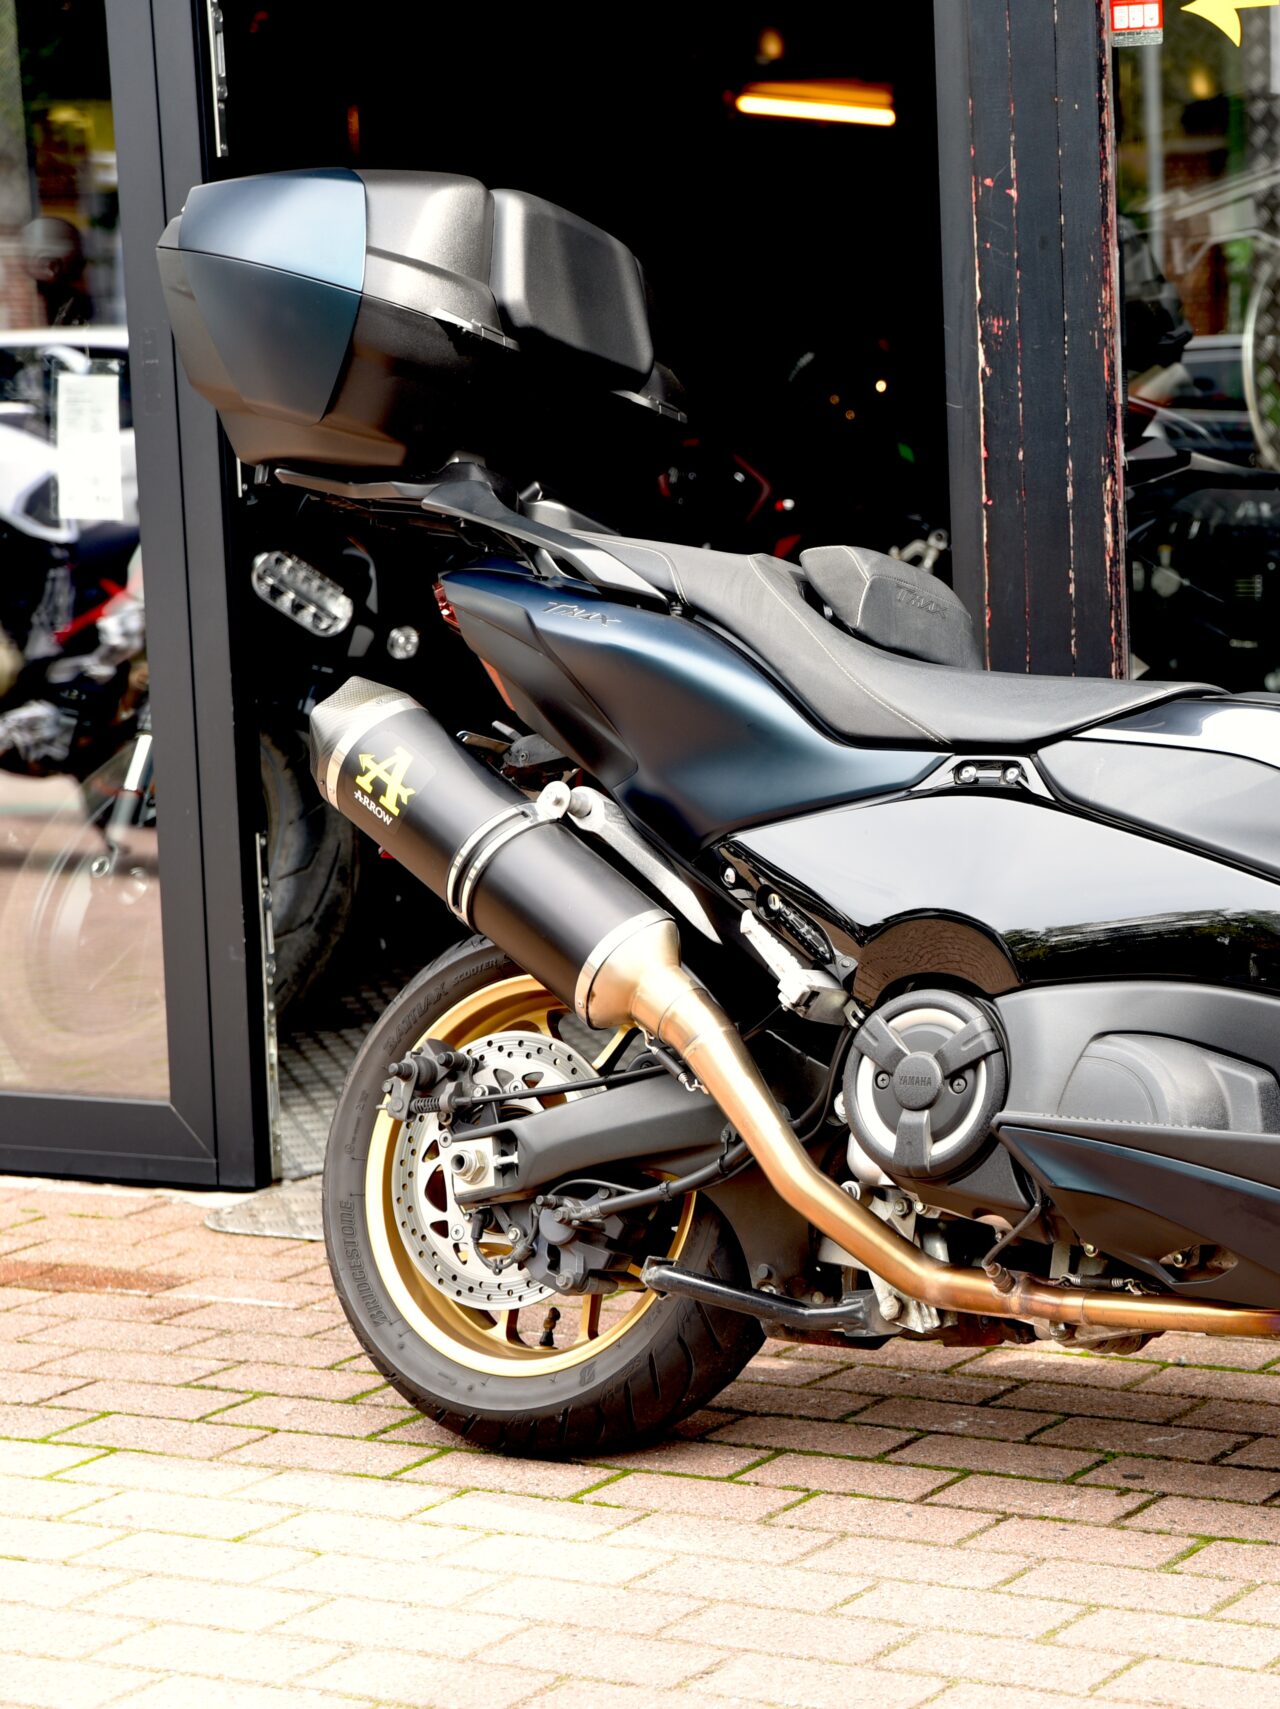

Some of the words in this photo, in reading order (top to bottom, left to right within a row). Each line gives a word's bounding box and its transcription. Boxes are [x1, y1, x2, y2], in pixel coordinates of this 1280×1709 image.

[354, 790, 393, 826] ARROW
[898, 1075, 932, 1087] YAMAHA
[340, 1199, 388, 1328] BRIDGESTONE
